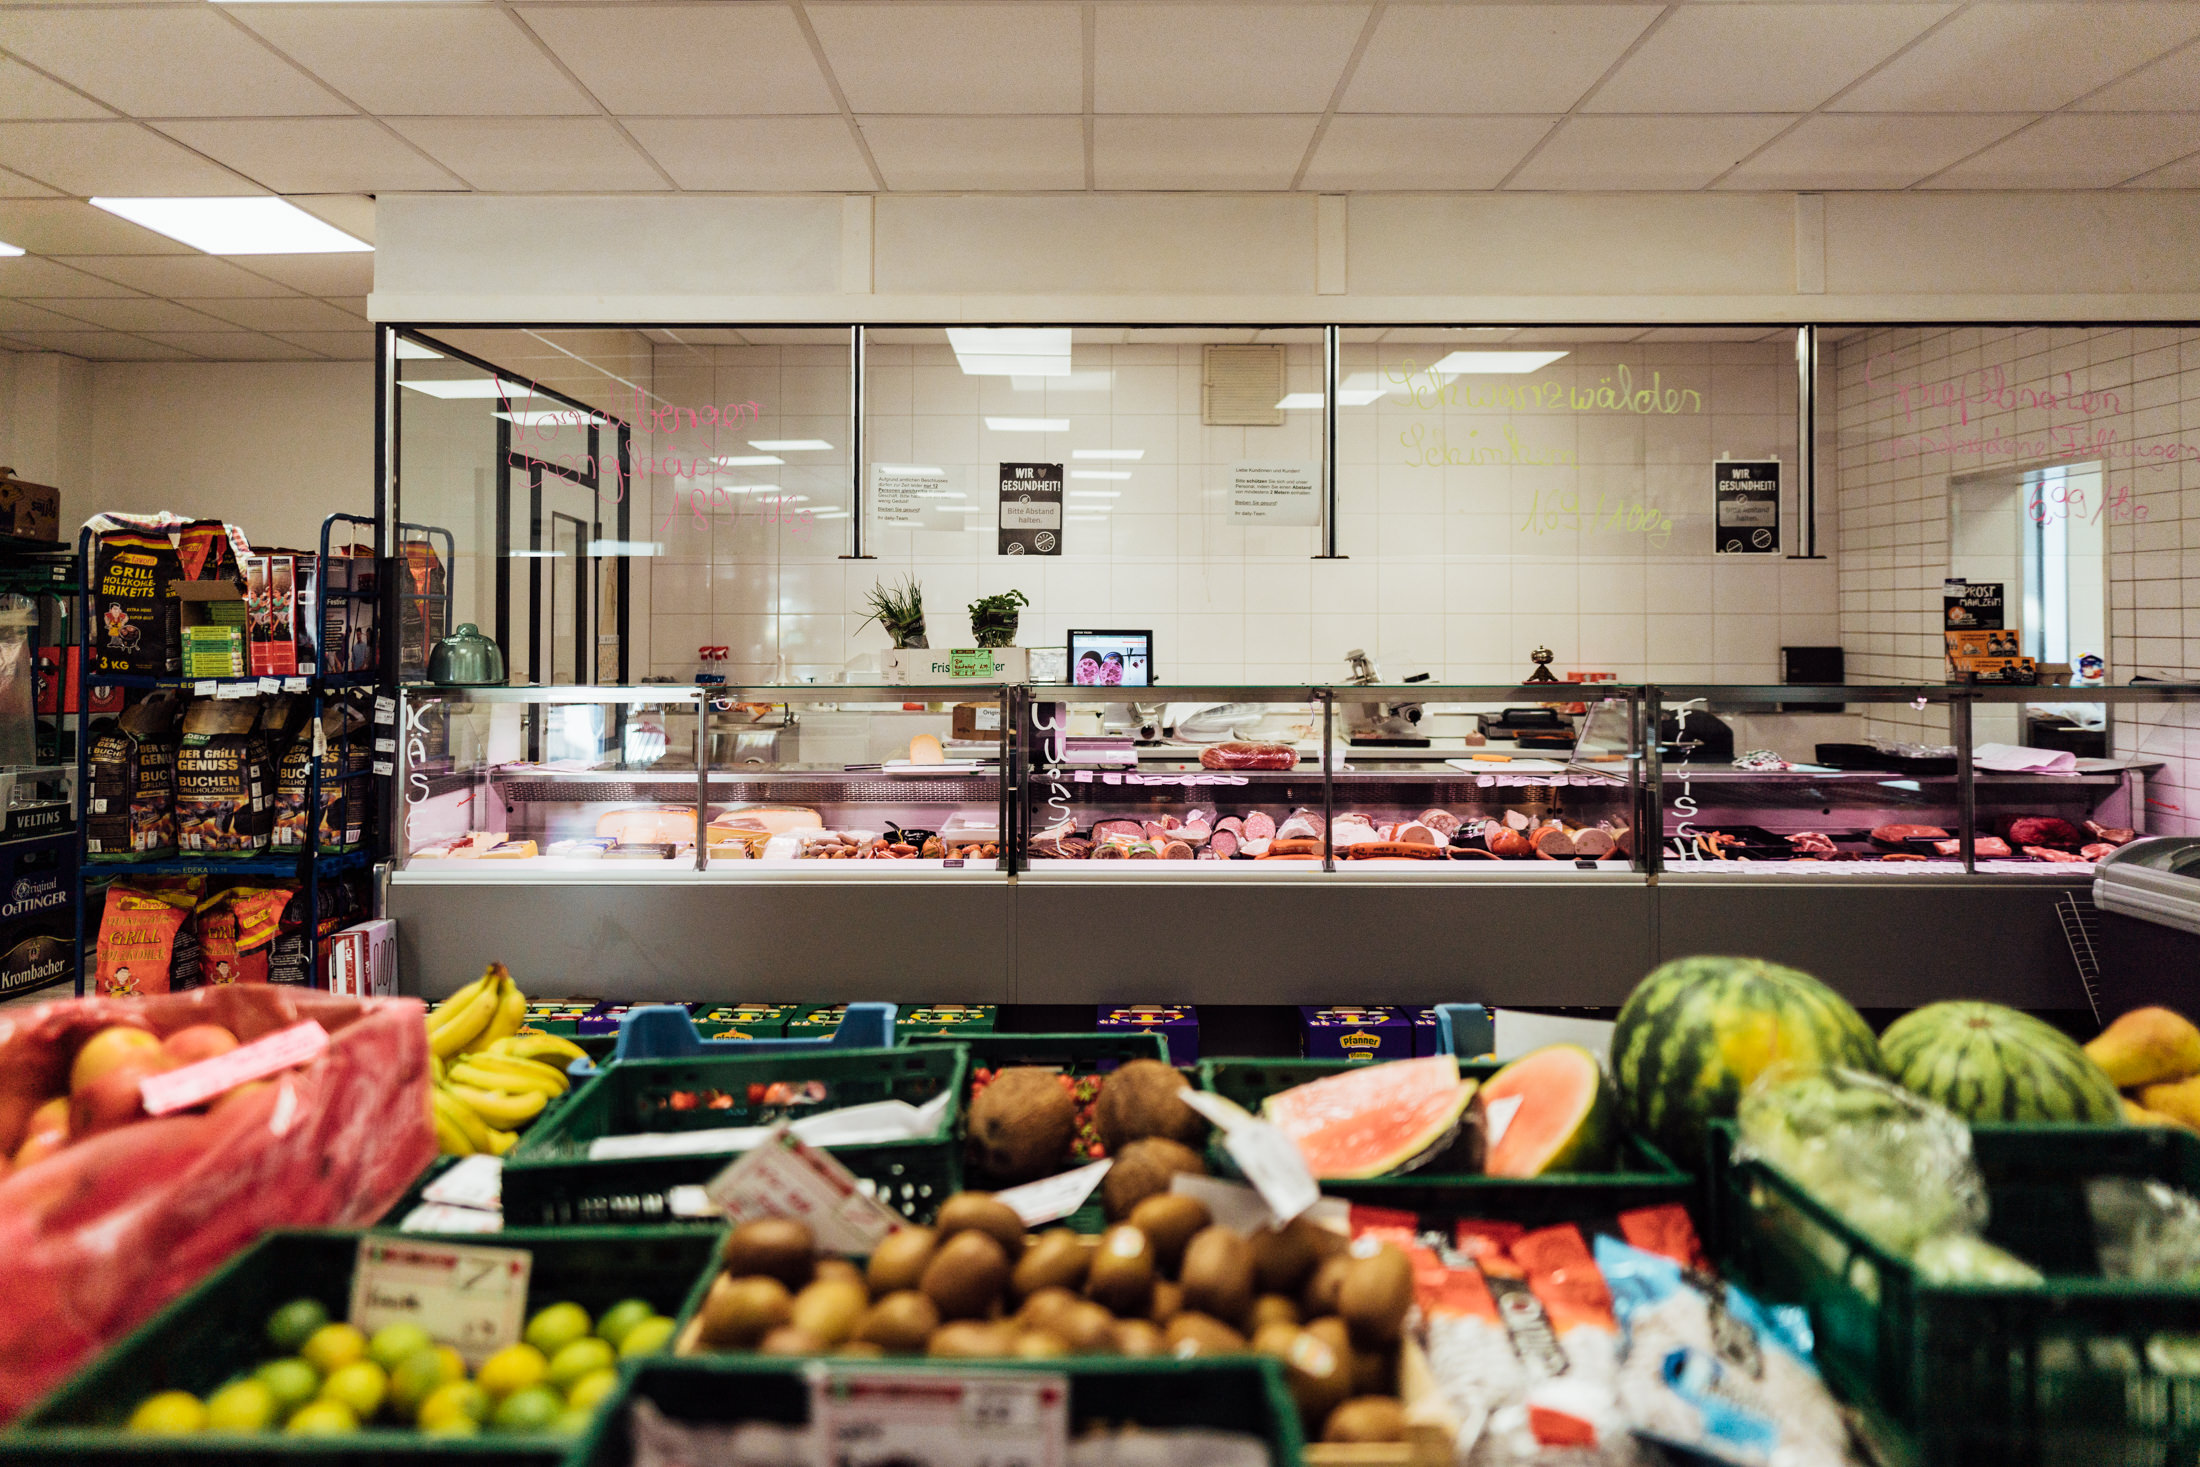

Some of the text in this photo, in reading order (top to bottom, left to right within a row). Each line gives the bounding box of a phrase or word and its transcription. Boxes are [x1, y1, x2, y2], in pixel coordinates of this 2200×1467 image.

[1384, 358, 1701, 414] Schwarzwälder
[1400, 423, 1580, 470] Schinken
[508, 440, 735, 505] Bergkäse
[1015, 468, 1033, 479] WIR
[1732, 469, 1750, 479] WIR
[1001, 480, 1061, 492] GESUNDHEIT!
[1719, 480, 1776, 491] GESUNDHEIT!
[1007, 507, 1055, 515] Bitte Abstand
[1018, 516, 1042, 524] halten.
[110, 565, 154, 579] GRILL
[103, 576, 157, 588] HOLZKOHLE-
[102, 585, 155, 598] BRIKETTS
[1964, 586, 1996, 597] PROST
[100, 656, 108, 669] 3
[111, 660, 129, 670] KG
[178, 749, 202, 759] DER
[177, 759, 239, 771] GENUSS
[405, 703, 433, 843] KÄSE
[1031, 701, 1077, 856] WURST
[178, 776, 240, 787] BUCHEN
[17, 810, 61, 829] VELTINS
[109, 928, 161, 945] GRILL
[1, 958, 66, 990] Krombacher
